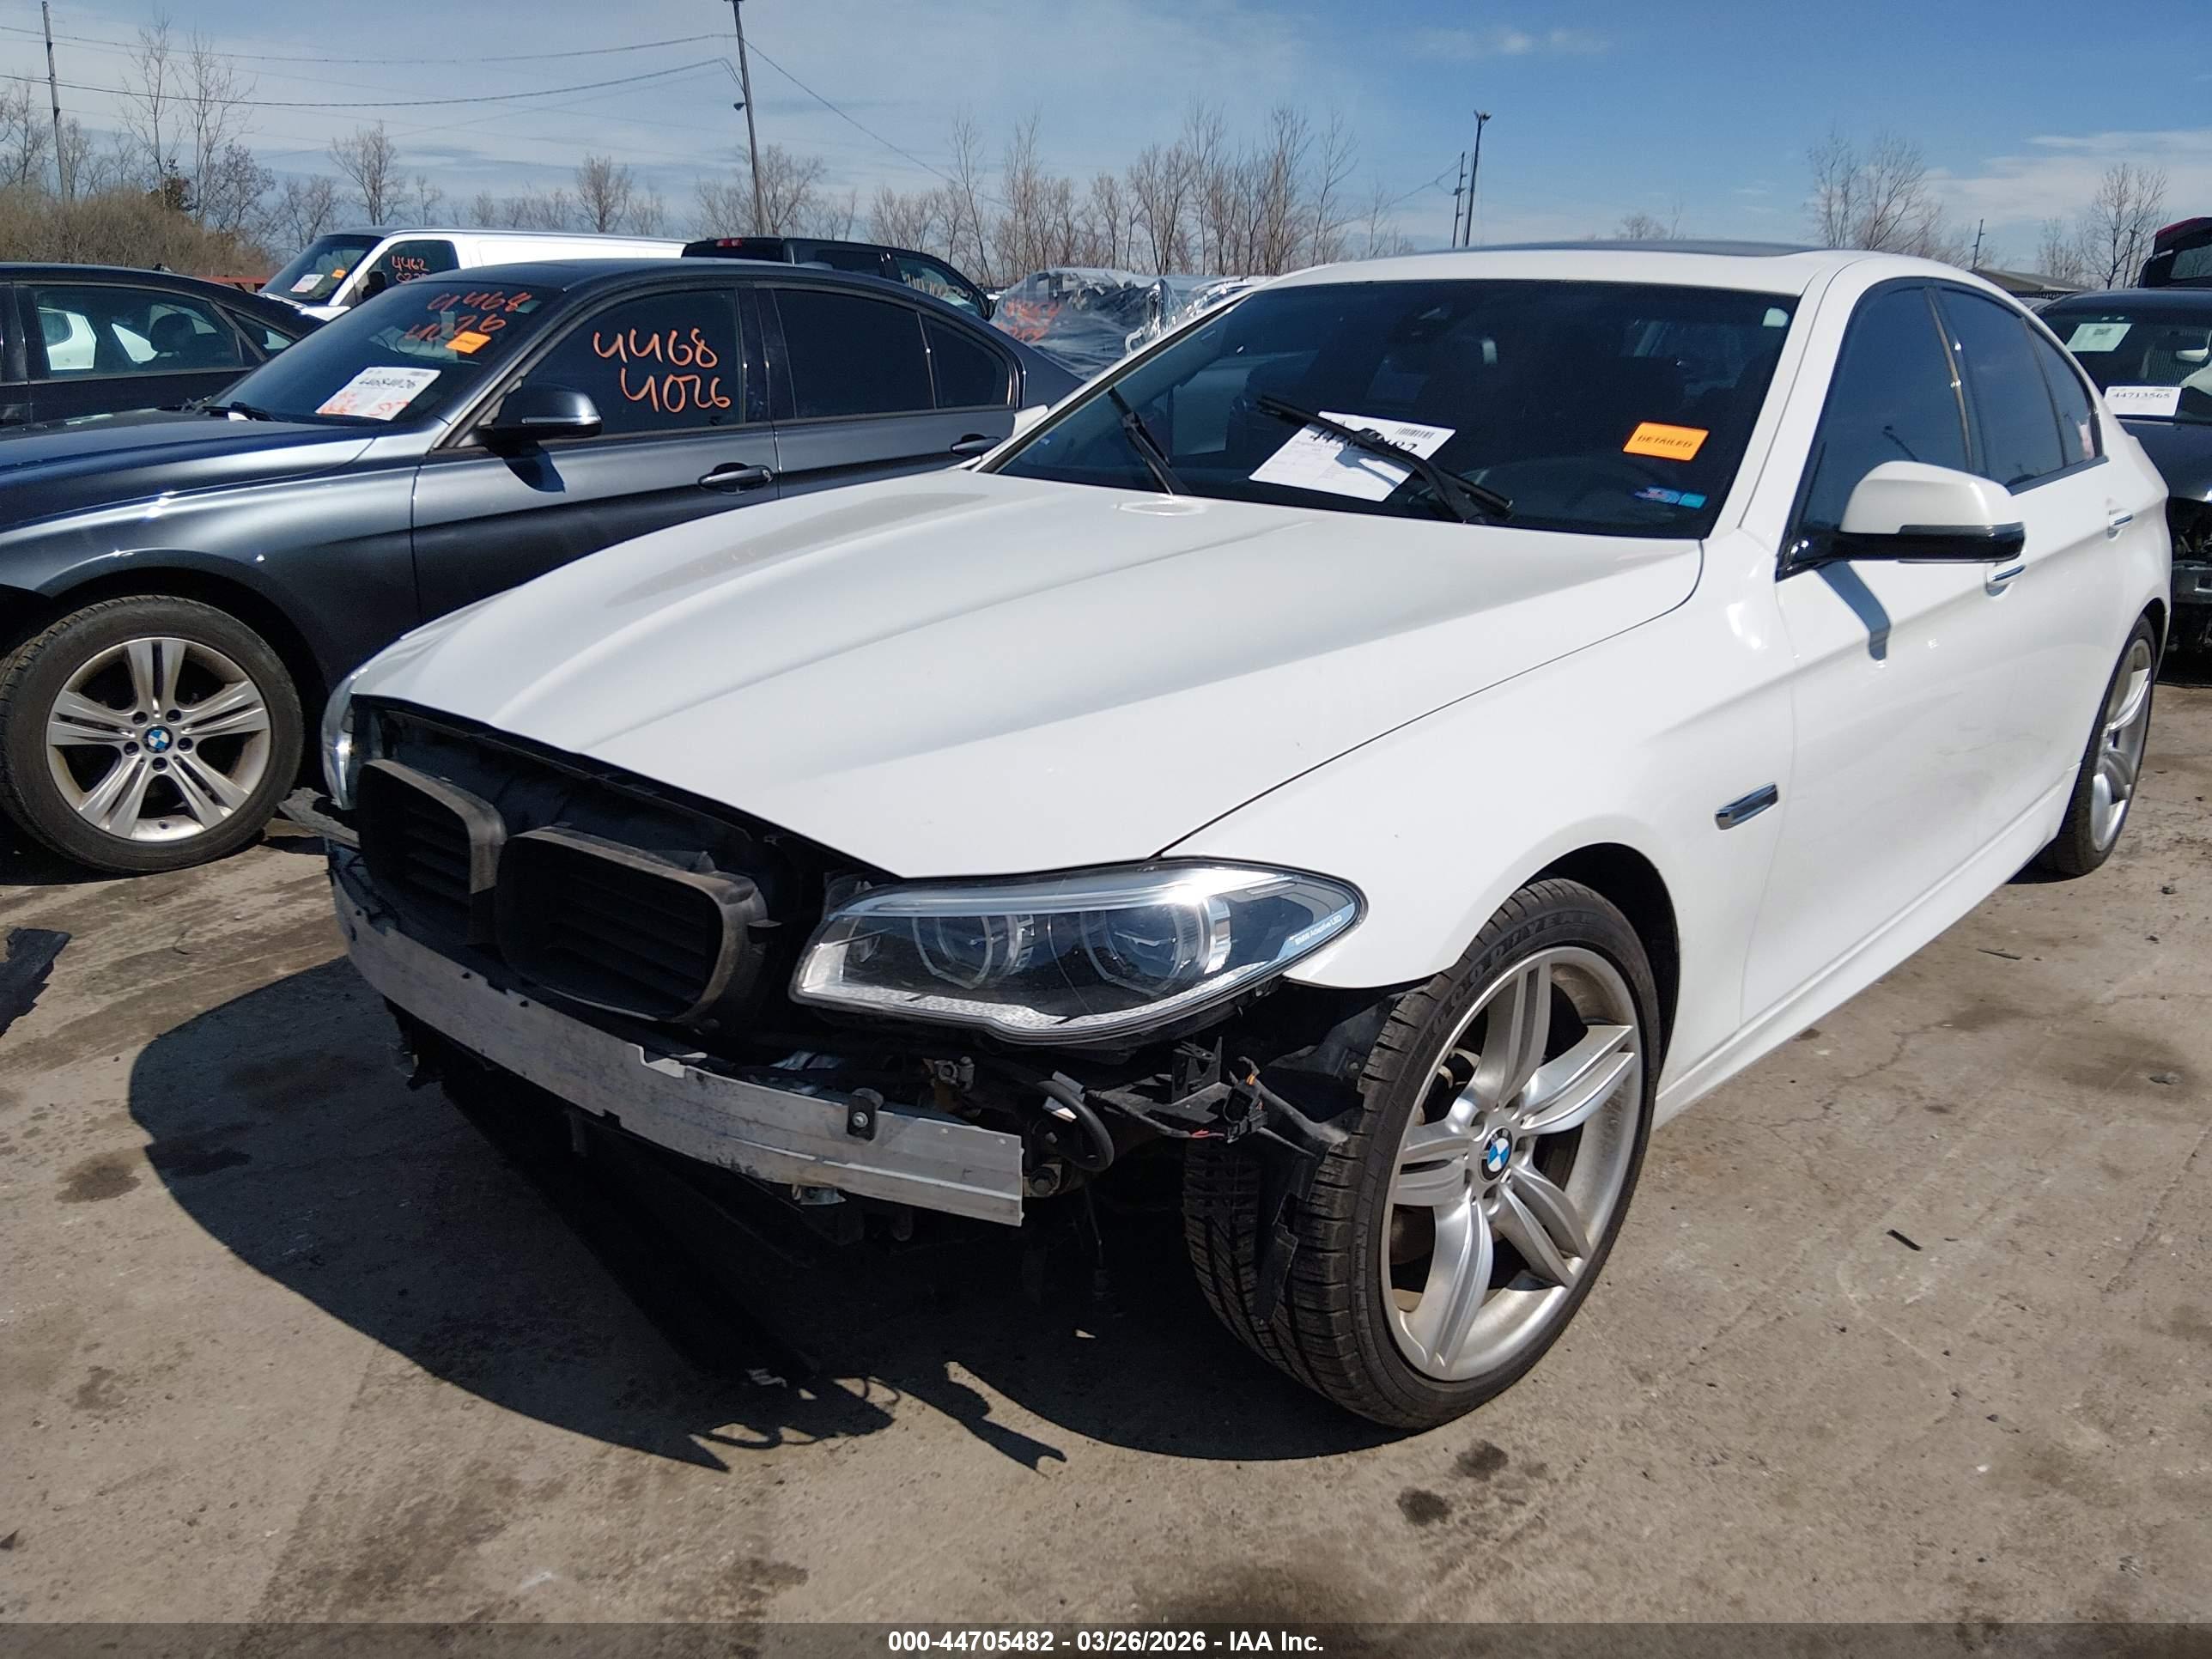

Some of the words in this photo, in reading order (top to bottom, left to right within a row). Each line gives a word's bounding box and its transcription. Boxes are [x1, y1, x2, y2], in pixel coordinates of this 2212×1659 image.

[391, 256, 429, 270] 4462
[427, 291, 532, 312] 4468
[592, 327, 718, 368] 4468
[620, 367, 731, 413] 4026
[1636, 434, 1693, 448] DETAILED
[1294, 932, 1311, 945] BMW
[1330, 914, 1343, 926] LED
